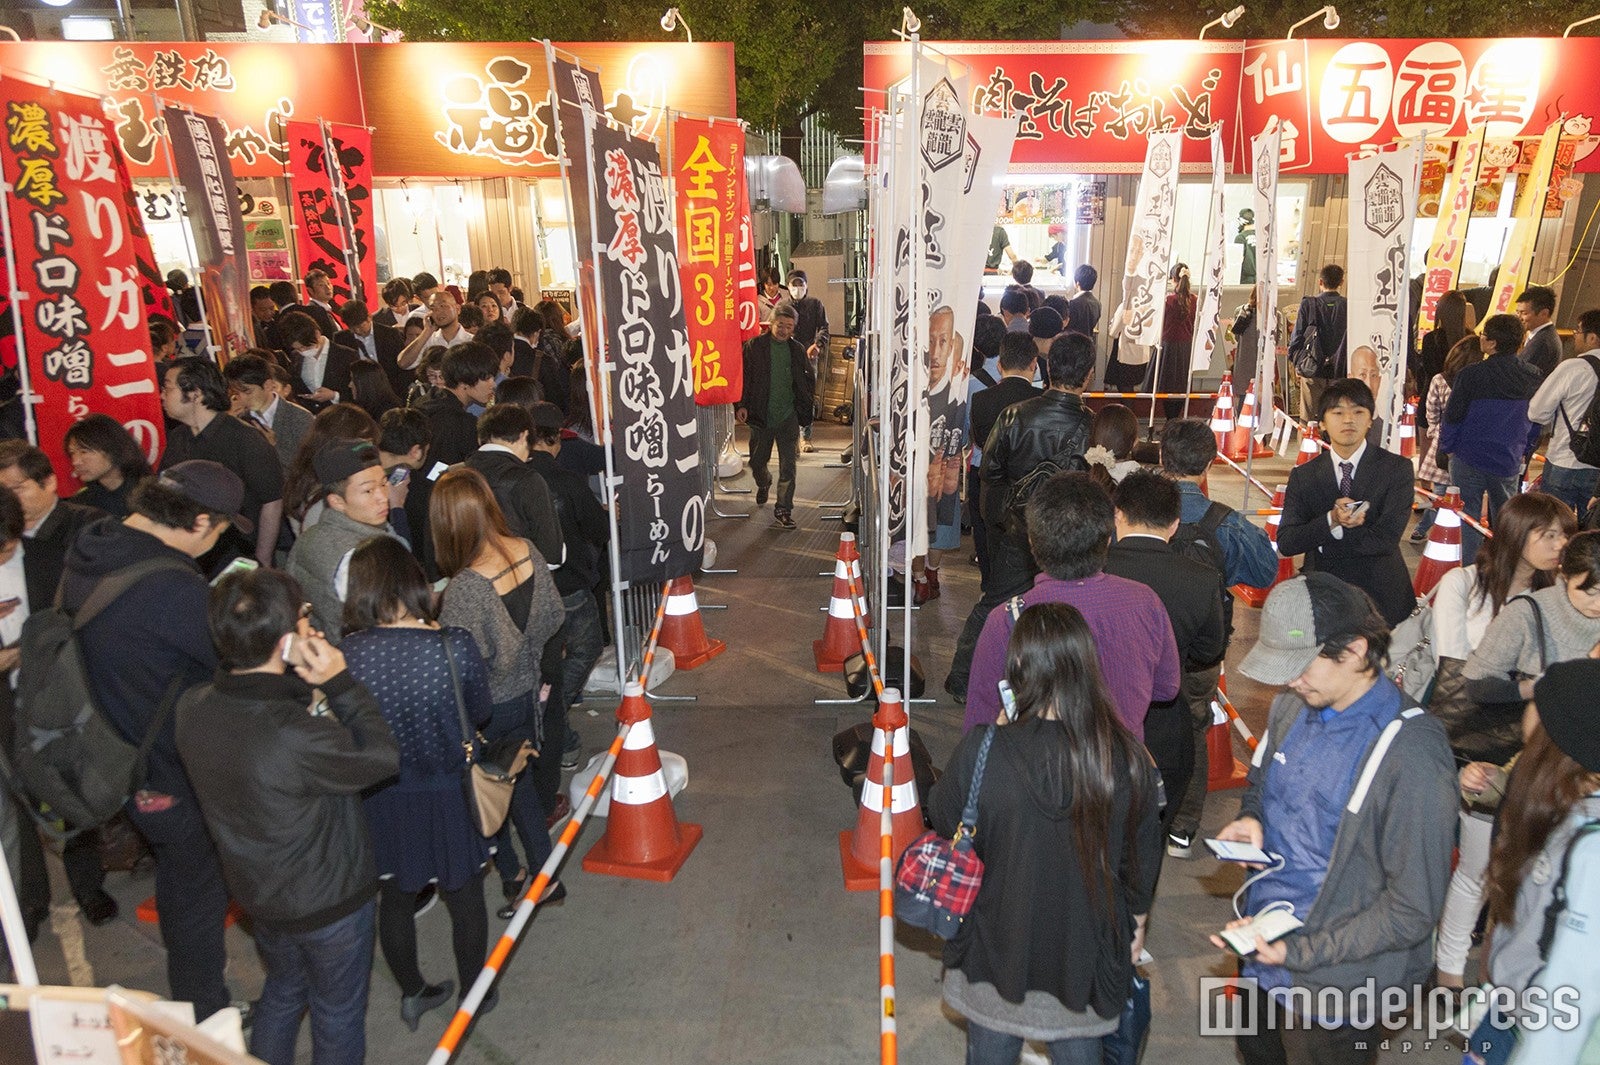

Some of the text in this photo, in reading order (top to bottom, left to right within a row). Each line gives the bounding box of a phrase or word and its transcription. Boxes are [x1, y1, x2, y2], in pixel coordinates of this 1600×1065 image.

[102, 46, 236, 92] 無鉄砲
[1245, 51, 1303, 164] 仙台
[1326, 60, 1525, 126] 五福星
[726, 143, 738, 222] ラーメンキング
[681, 134, 729, 395] 全国3位
